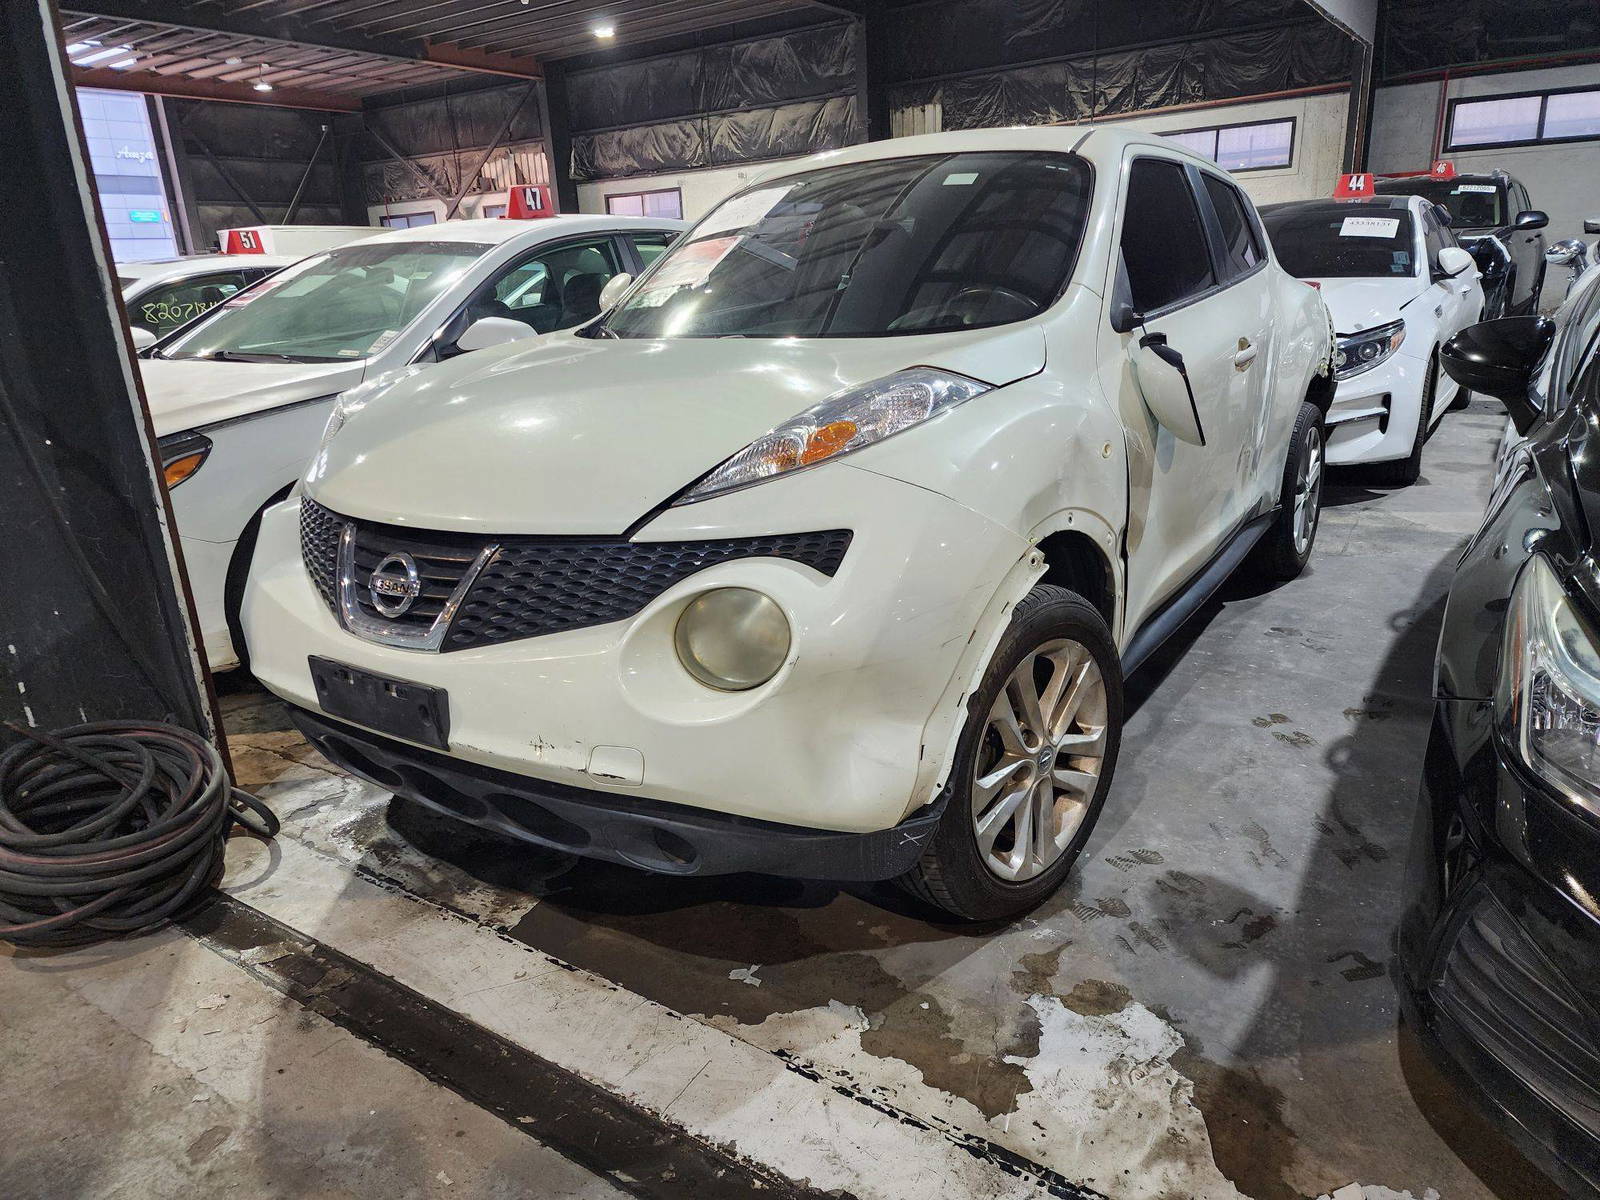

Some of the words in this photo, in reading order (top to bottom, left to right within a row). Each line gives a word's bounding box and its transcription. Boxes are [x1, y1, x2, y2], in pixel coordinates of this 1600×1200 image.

[1348, 175, 1365, 191] 44
[525, 187, 543, 210] 47
[239, 231, 257, 249] 51
